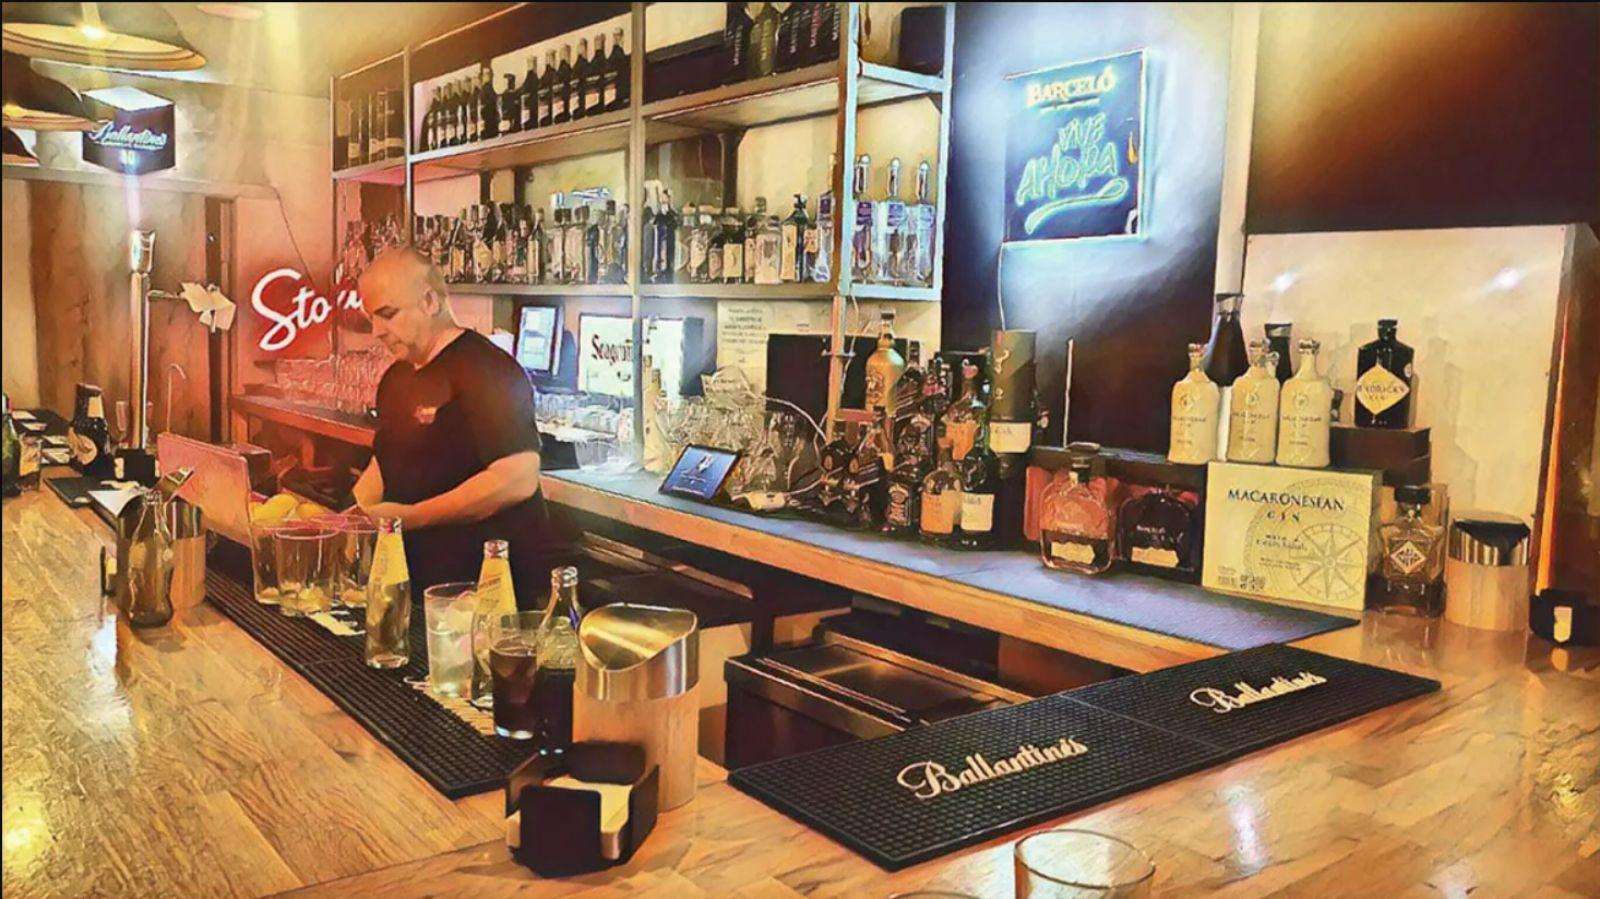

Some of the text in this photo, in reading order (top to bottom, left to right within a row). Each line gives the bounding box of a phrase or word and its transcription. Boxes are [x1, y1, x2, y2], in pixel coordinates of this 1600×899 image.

[1026, 64, 1116, 107] BARCELÓ
[1015, 141, 1118, 206] AHORA
[1227, 488, 1345, 512] MACARONESIAN
[1189, 671, 1327, 714] Ballantine's
[896, 737, 1088, 799] Ballantine's
